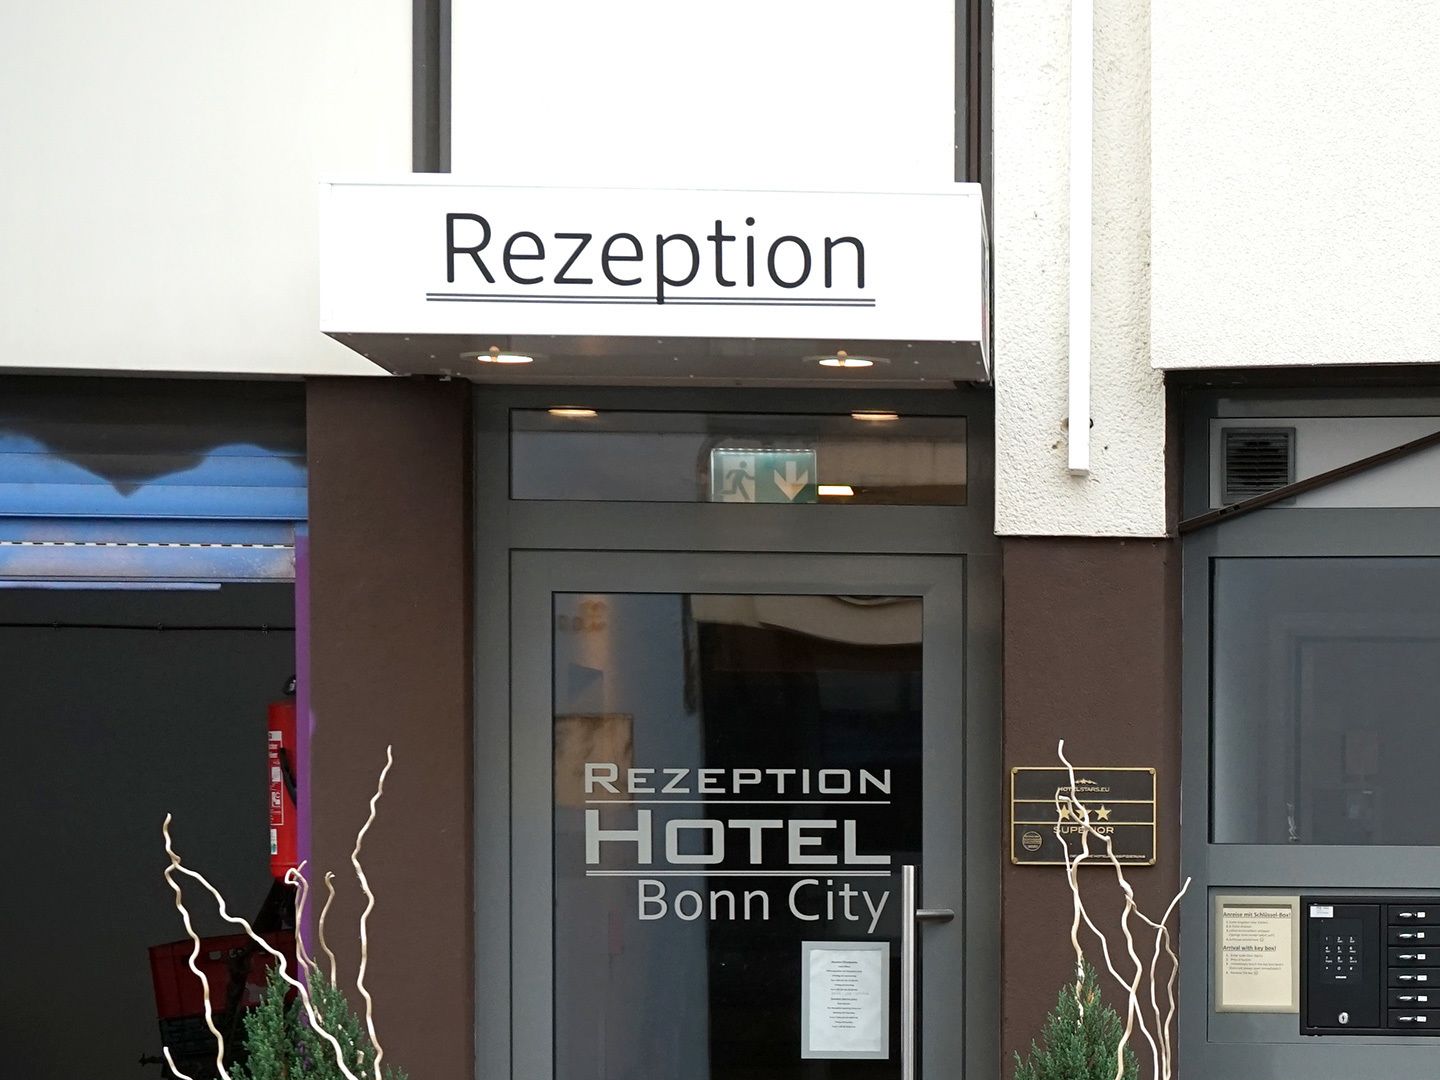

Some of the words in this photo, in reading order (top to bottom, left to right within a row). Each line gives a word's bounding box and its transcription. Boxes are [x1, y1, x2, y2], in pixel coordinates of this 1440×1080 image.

[446, 213, 865, 304] Rezeption
[585, 809, 891, 864] HOTEL
[638, 879, 769, 920] Bonn
[788, 879, 890, 934] City
